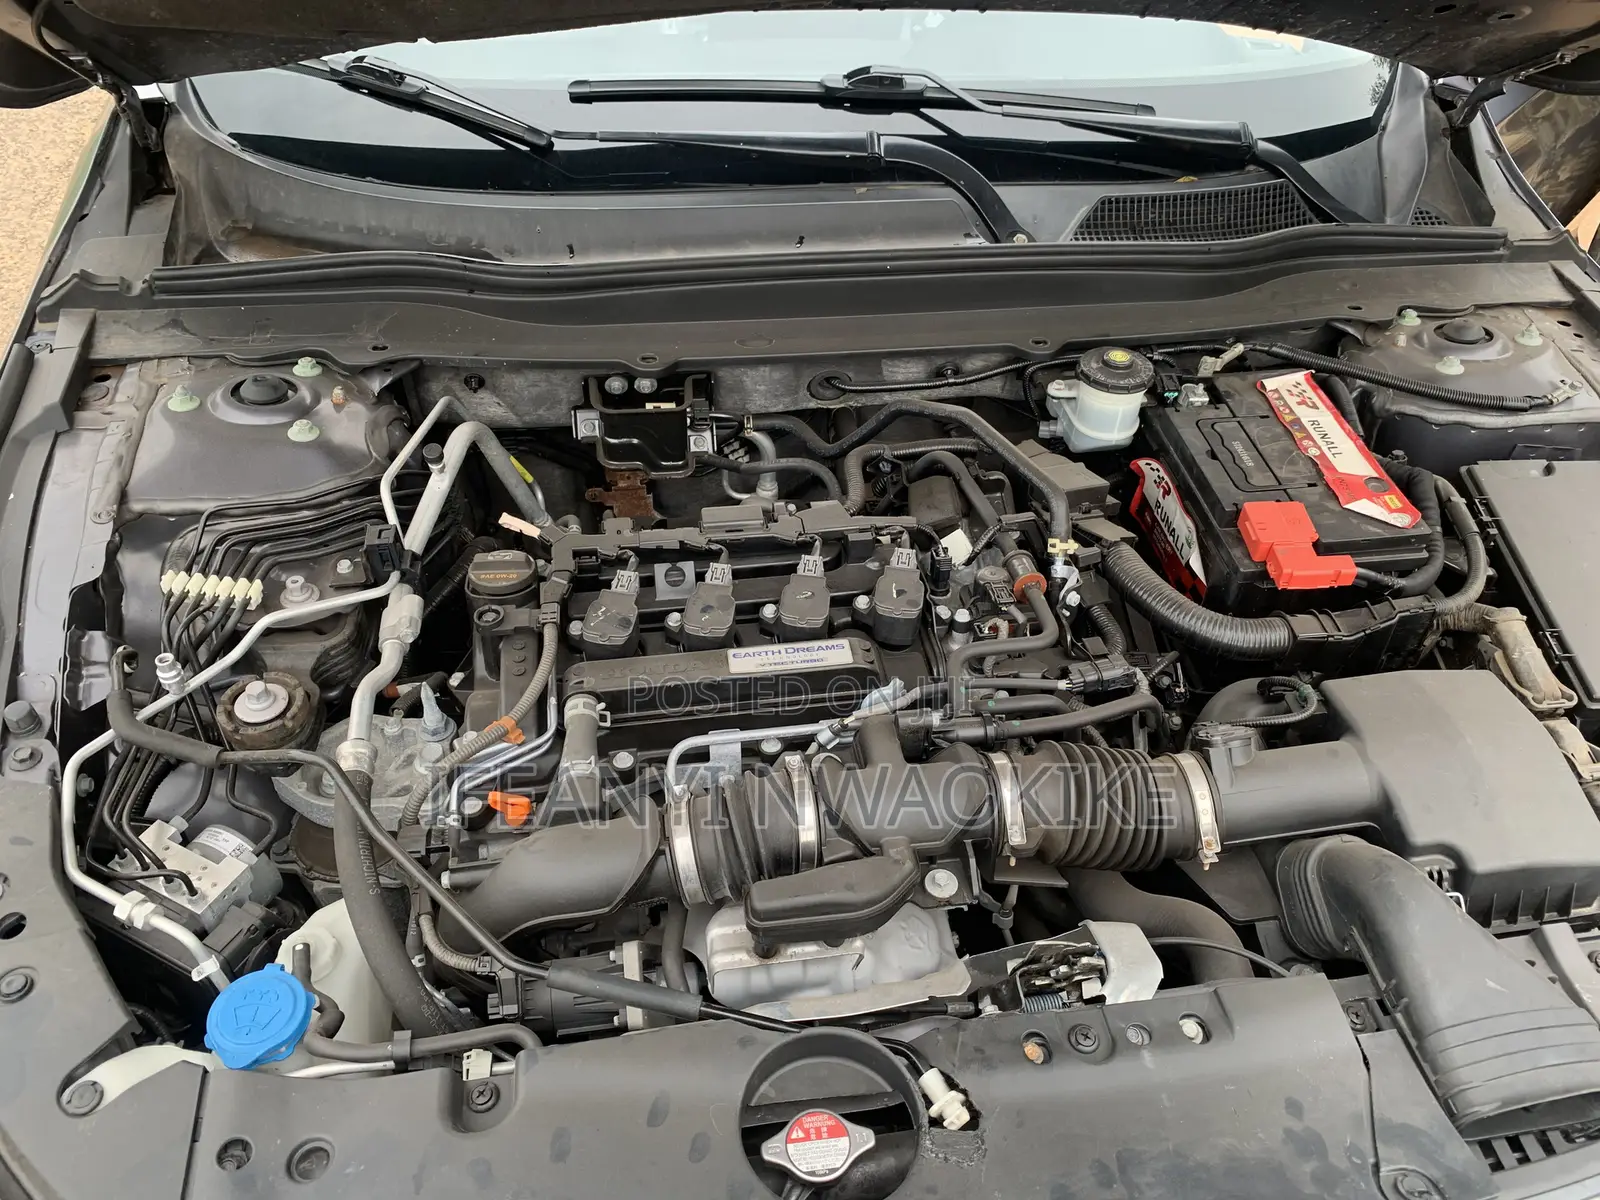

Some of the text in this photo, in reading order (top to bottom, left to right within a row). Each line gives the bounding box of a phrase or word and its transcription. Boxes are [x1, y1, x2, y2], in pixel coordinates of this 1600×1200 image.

[1308, 419, 1343, 459] RUNALL
[1154, 499, 1185, 560] RUNALL
[732, 643, 846, 659] EARTH DREAMS
[802, 1114, 828, 1124] DANGER
